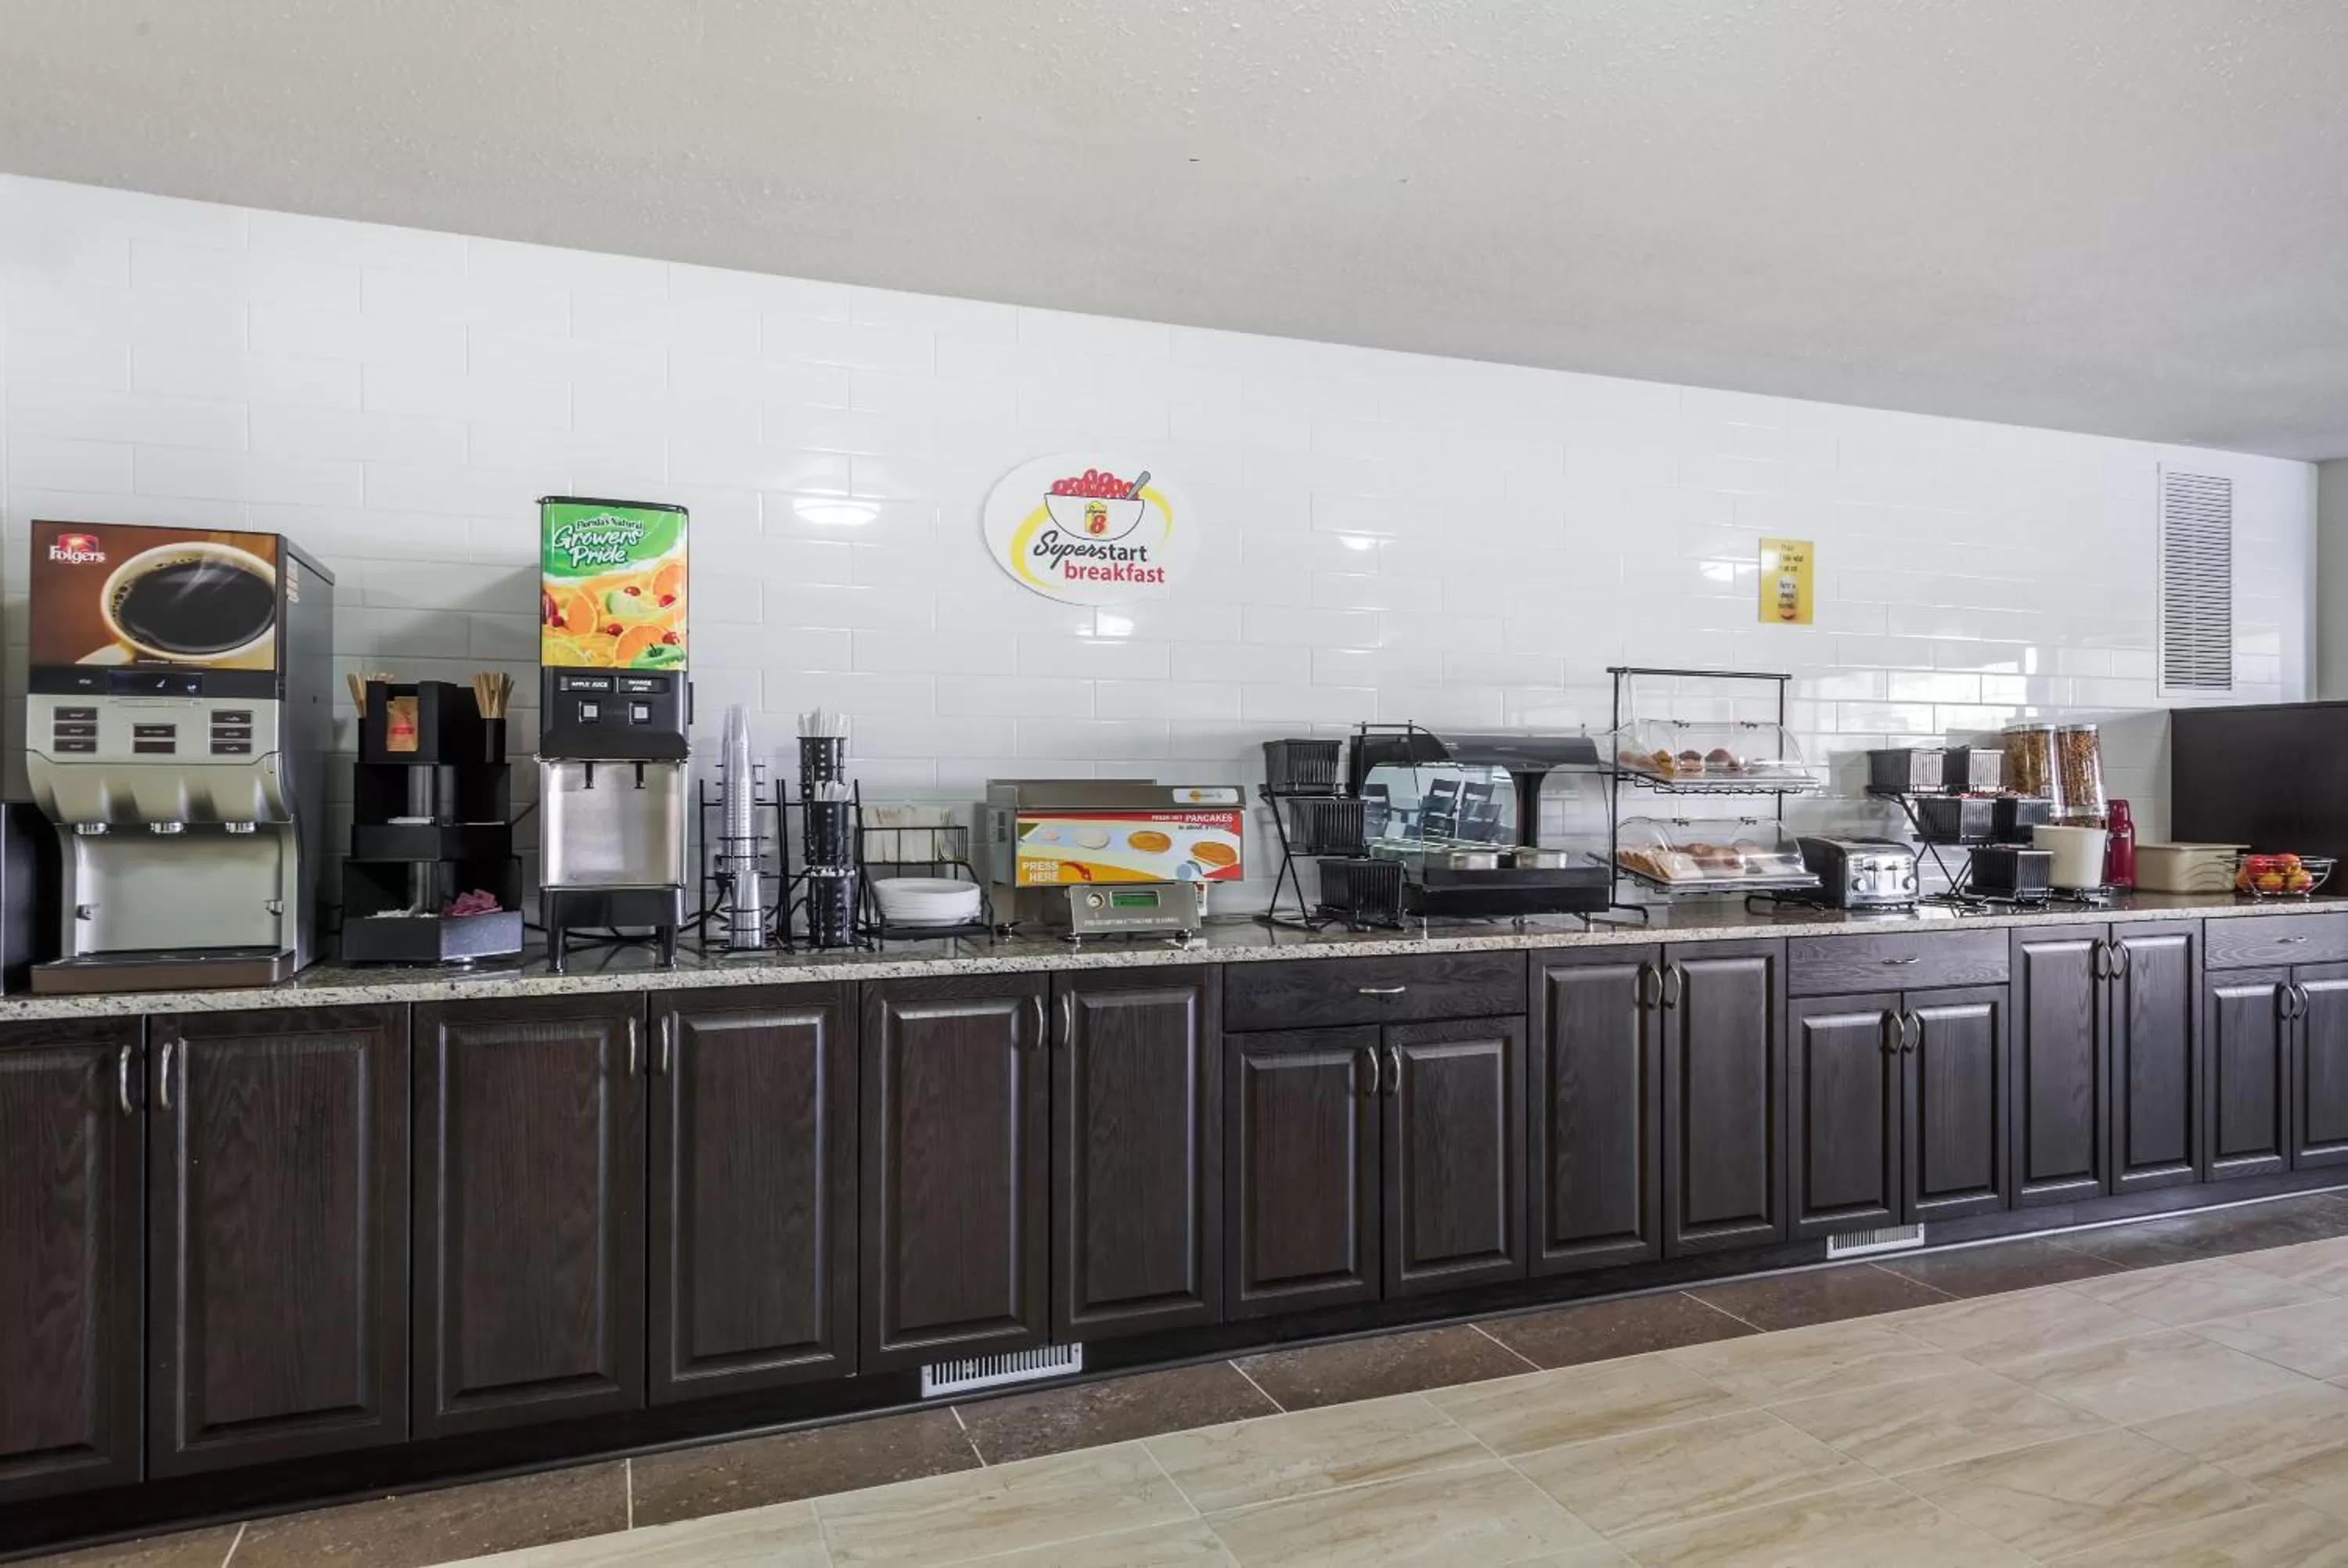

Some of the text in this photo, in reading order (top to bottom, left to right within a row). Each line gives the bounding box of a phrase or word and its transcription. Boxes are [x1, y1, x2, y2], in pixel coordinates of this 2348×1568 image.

[611, 517, 643, 530] Natural
[1089, 514, 1106, 534] 8
[49, 545, 106, 564] Folgers
[570, 545, 627, 567] Pride
[1033, 530, 1147, 570] Superstart
[1064, 560, 1165, 584] breakfast
[1185, 813, 1233, 822] PANCAKES
[1022, 861, 1059, 872] PRESS
[1028, 872, 1059, 883] HERE
